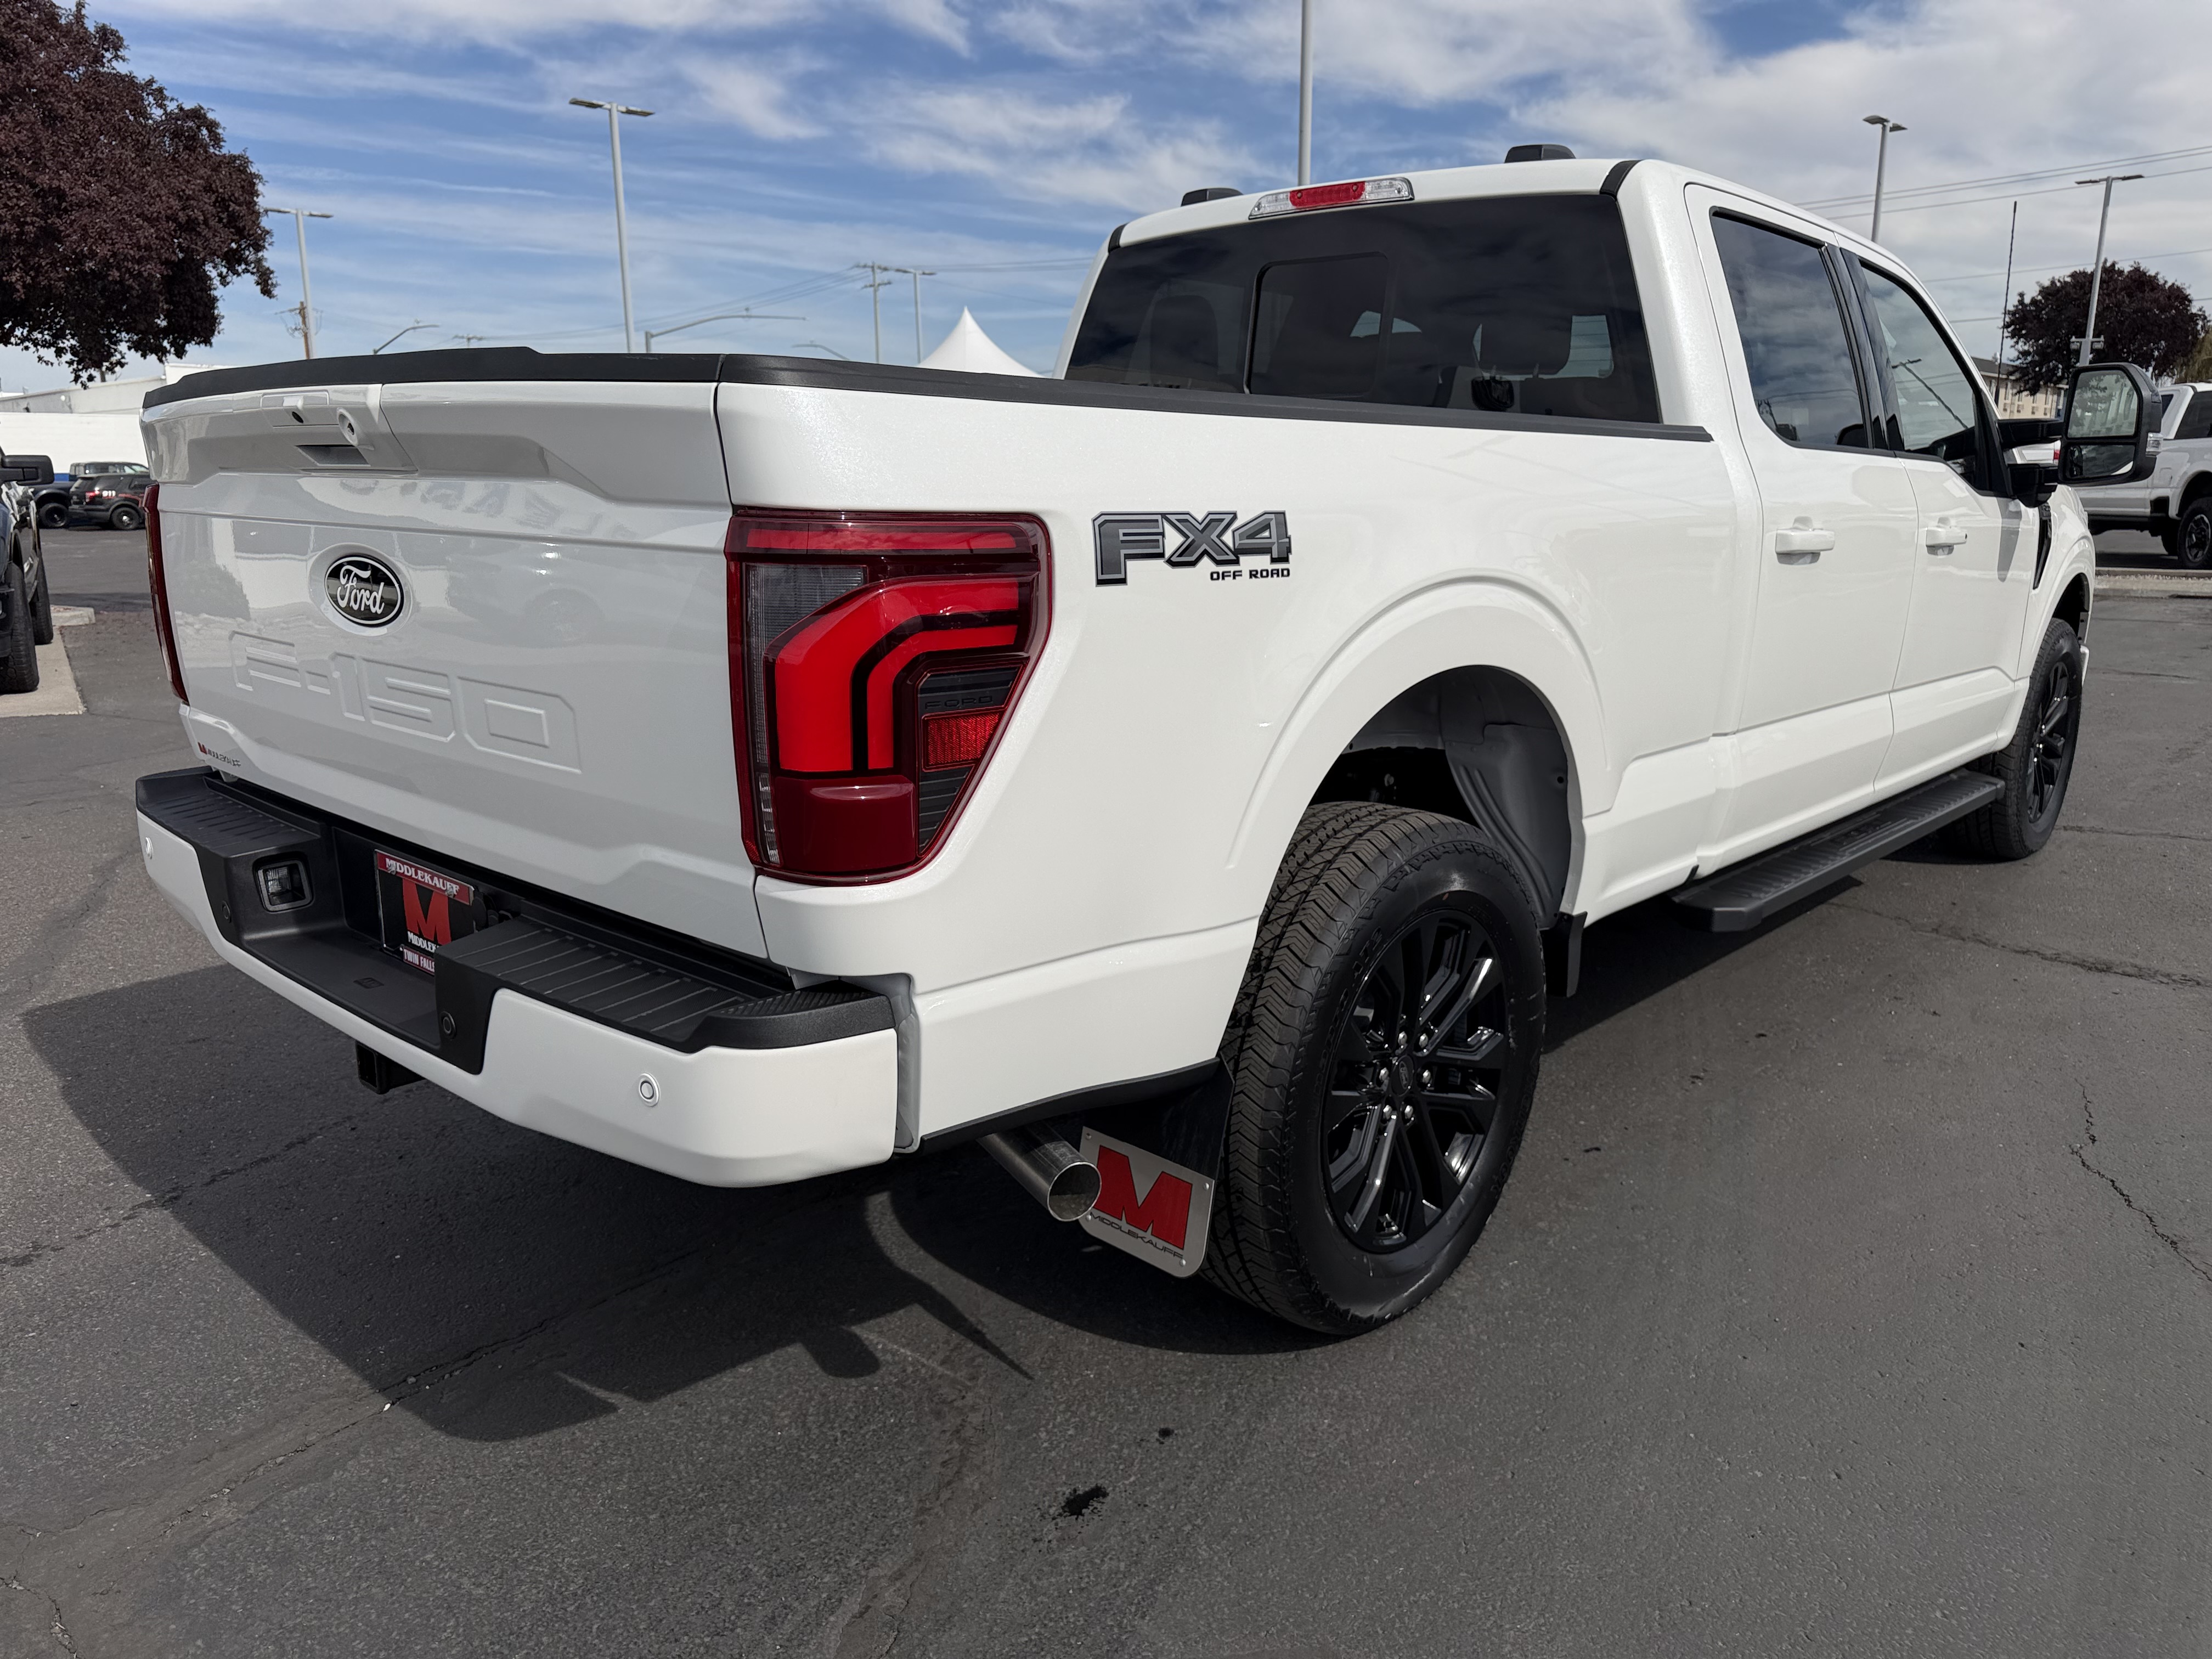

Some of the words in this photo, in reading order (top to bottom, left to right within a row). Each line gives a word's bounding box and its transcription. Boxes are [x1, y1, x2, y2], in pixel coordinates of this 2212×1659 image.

[1091, 511, 1292, 587] FX4
[336, 565, 385, 614] Ford
[1210, 570, 1243, 581] OFF
[1249, 568, 1290, 579] ROAD
[228, 630, 583, 774] F-150
[924, 695, 992, 709] FORD
[385, 857, 460, 896] MIDDLEKAUFF
[402, 878, 452, 946] M
[403, 949, 419, 966] TWIN
[407, 930, 439, 953] MIDDLEK
[1092, 1144, 1193, 1250] M
[1090, 1211, 1184, 1260] MIDDLEKAUFF
